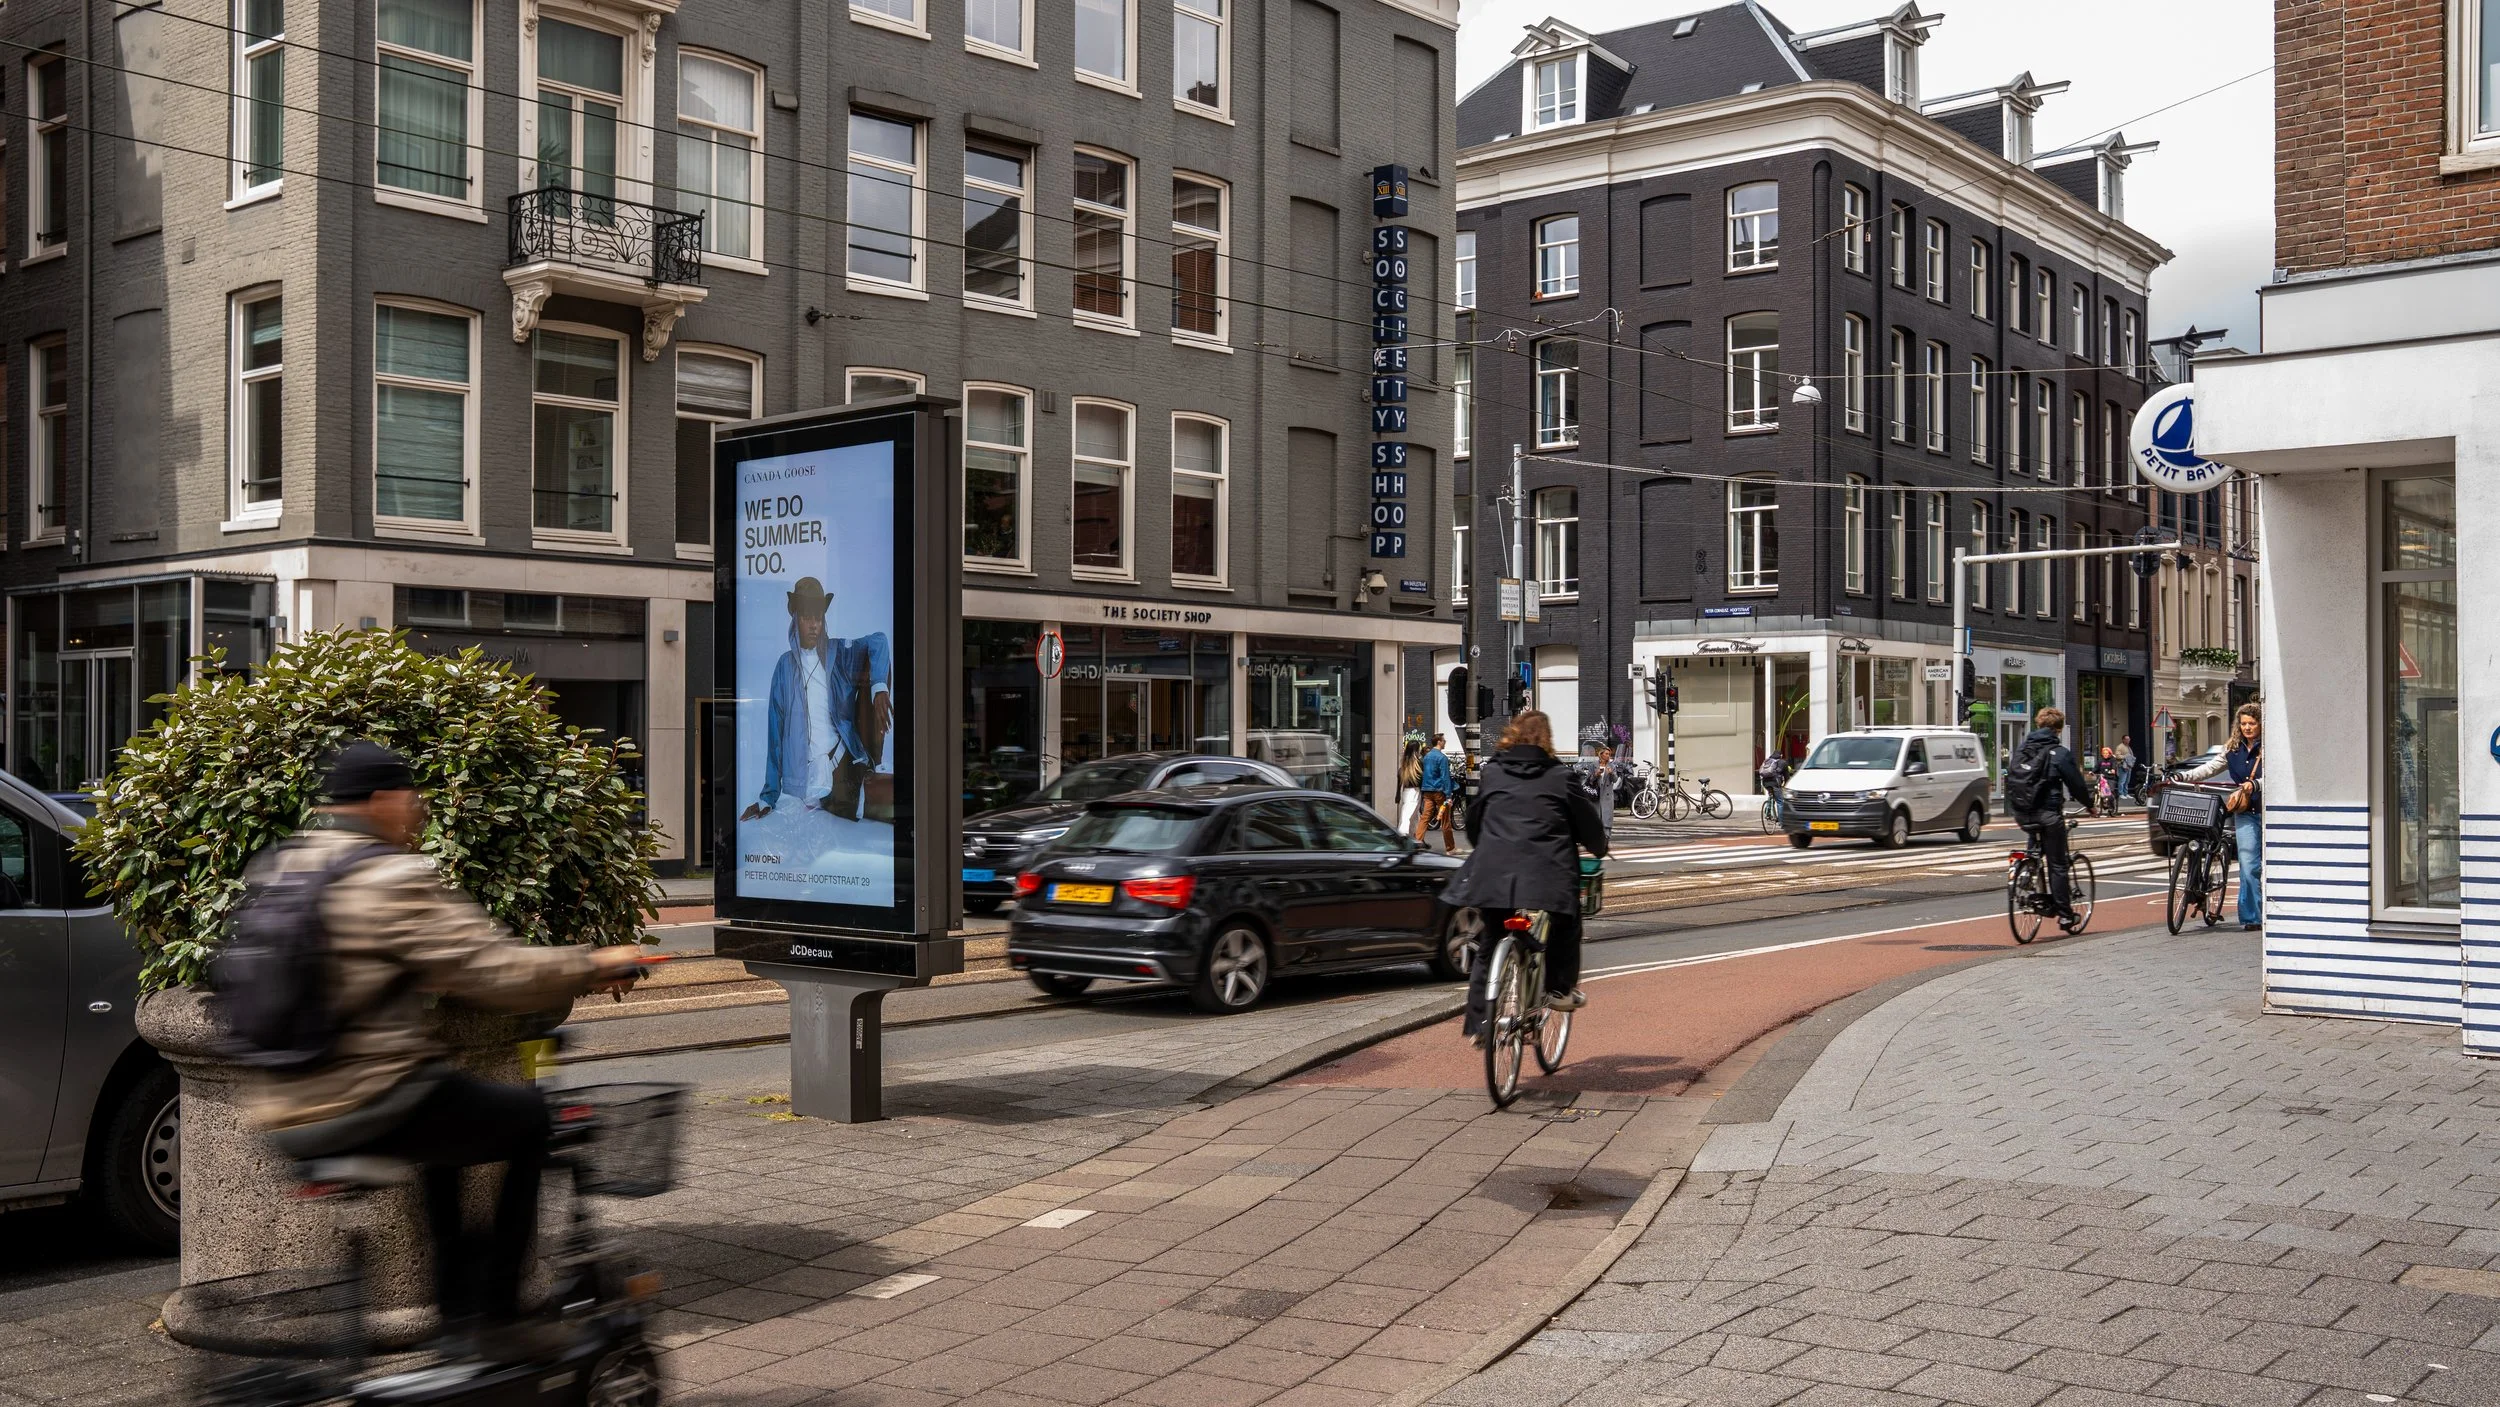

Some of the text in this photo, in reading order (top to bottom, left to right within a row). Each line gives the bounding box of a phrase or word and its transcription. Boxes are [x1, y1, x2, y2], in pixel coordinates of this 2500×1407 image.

[1374, 229, 1390, 553] SOCIETY SHOP
[1393, 230, 1405, 553] SOCIETY SHOP
[744, 465, 816, 484] CANADA GOOSE
[2140, 447, 2179, 480] PETIT
[744, 494, 803, 521] WE DO
[744, 520, 827, 549] SUMMER,
[744, 552, 785, 575] TOO.
[1103, 605, 1212, 624] THE SOCIETY SHOP
[744, 854, 781, 864] NOW OPEN
[744, 870, 870, 887] PIETER CORNELISZ HOOFTSTRAAT 29
[790, 944, 833, 958] JCDecaux
